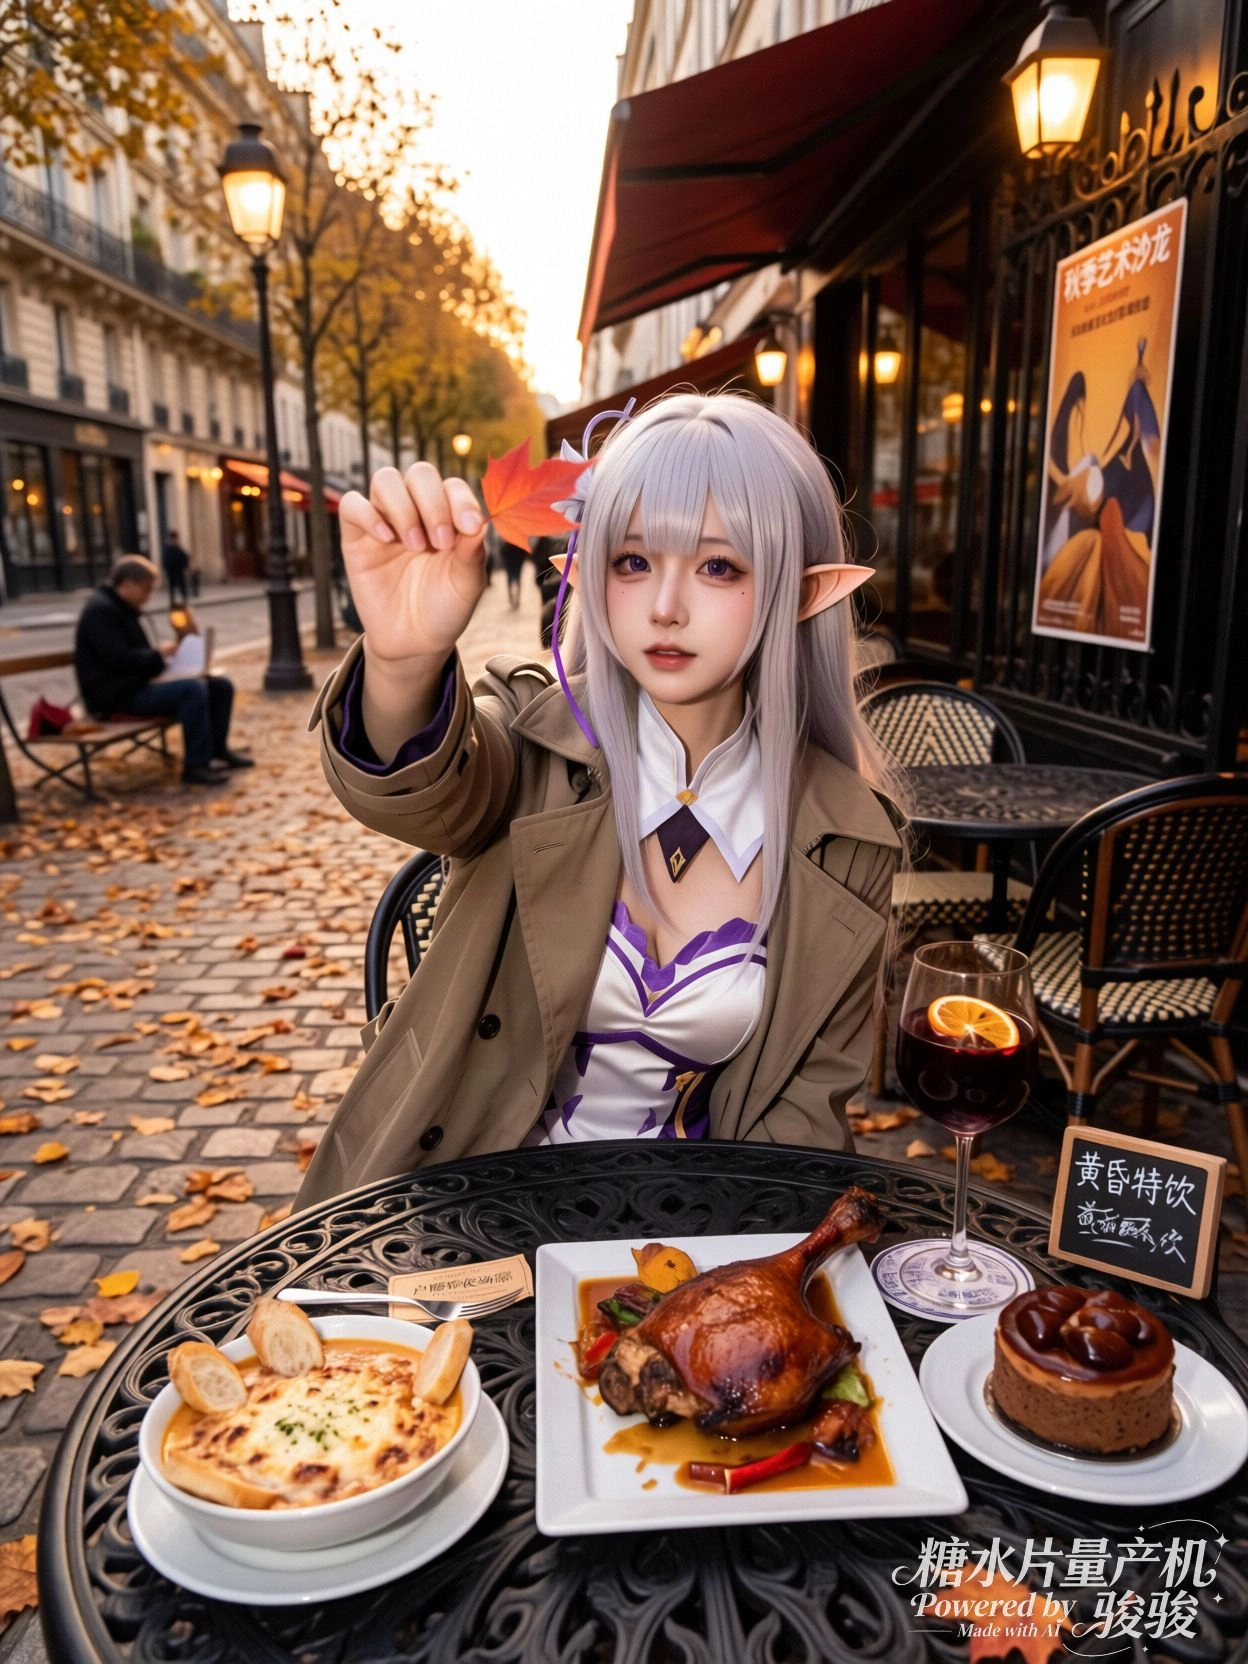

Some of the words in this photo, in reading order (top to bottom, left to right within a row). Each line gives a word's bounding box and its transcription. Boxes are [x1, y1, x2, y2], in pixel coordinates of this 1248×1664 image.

[1064, 222, 1173, 303] 秋季艺术沙龙
[1075, 1151, 1197, 1216] 黄昏特饮
